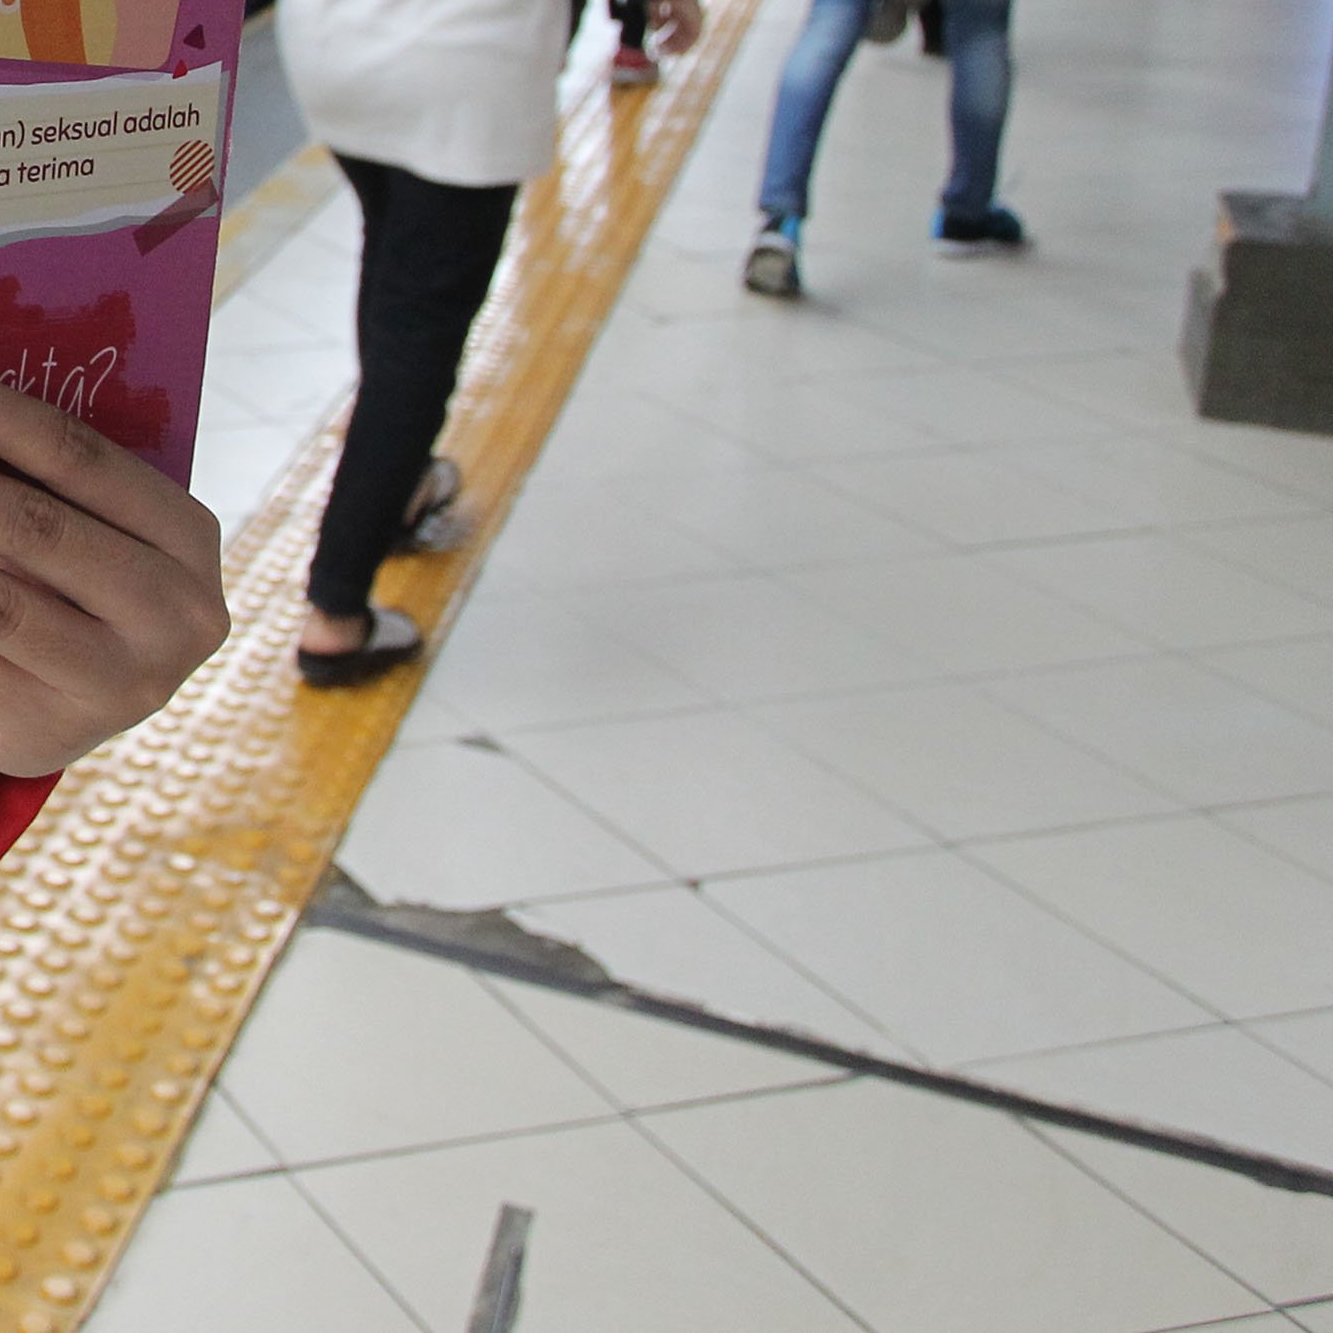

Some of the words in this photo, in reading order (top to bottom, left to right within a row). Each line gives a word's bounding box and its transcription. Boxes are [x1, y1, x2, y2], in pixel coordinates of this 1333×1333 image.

[30, 110, 119, 146] seksual
[123, 102, 200, 134] adalah
[16, 158, 95, 184] terima
